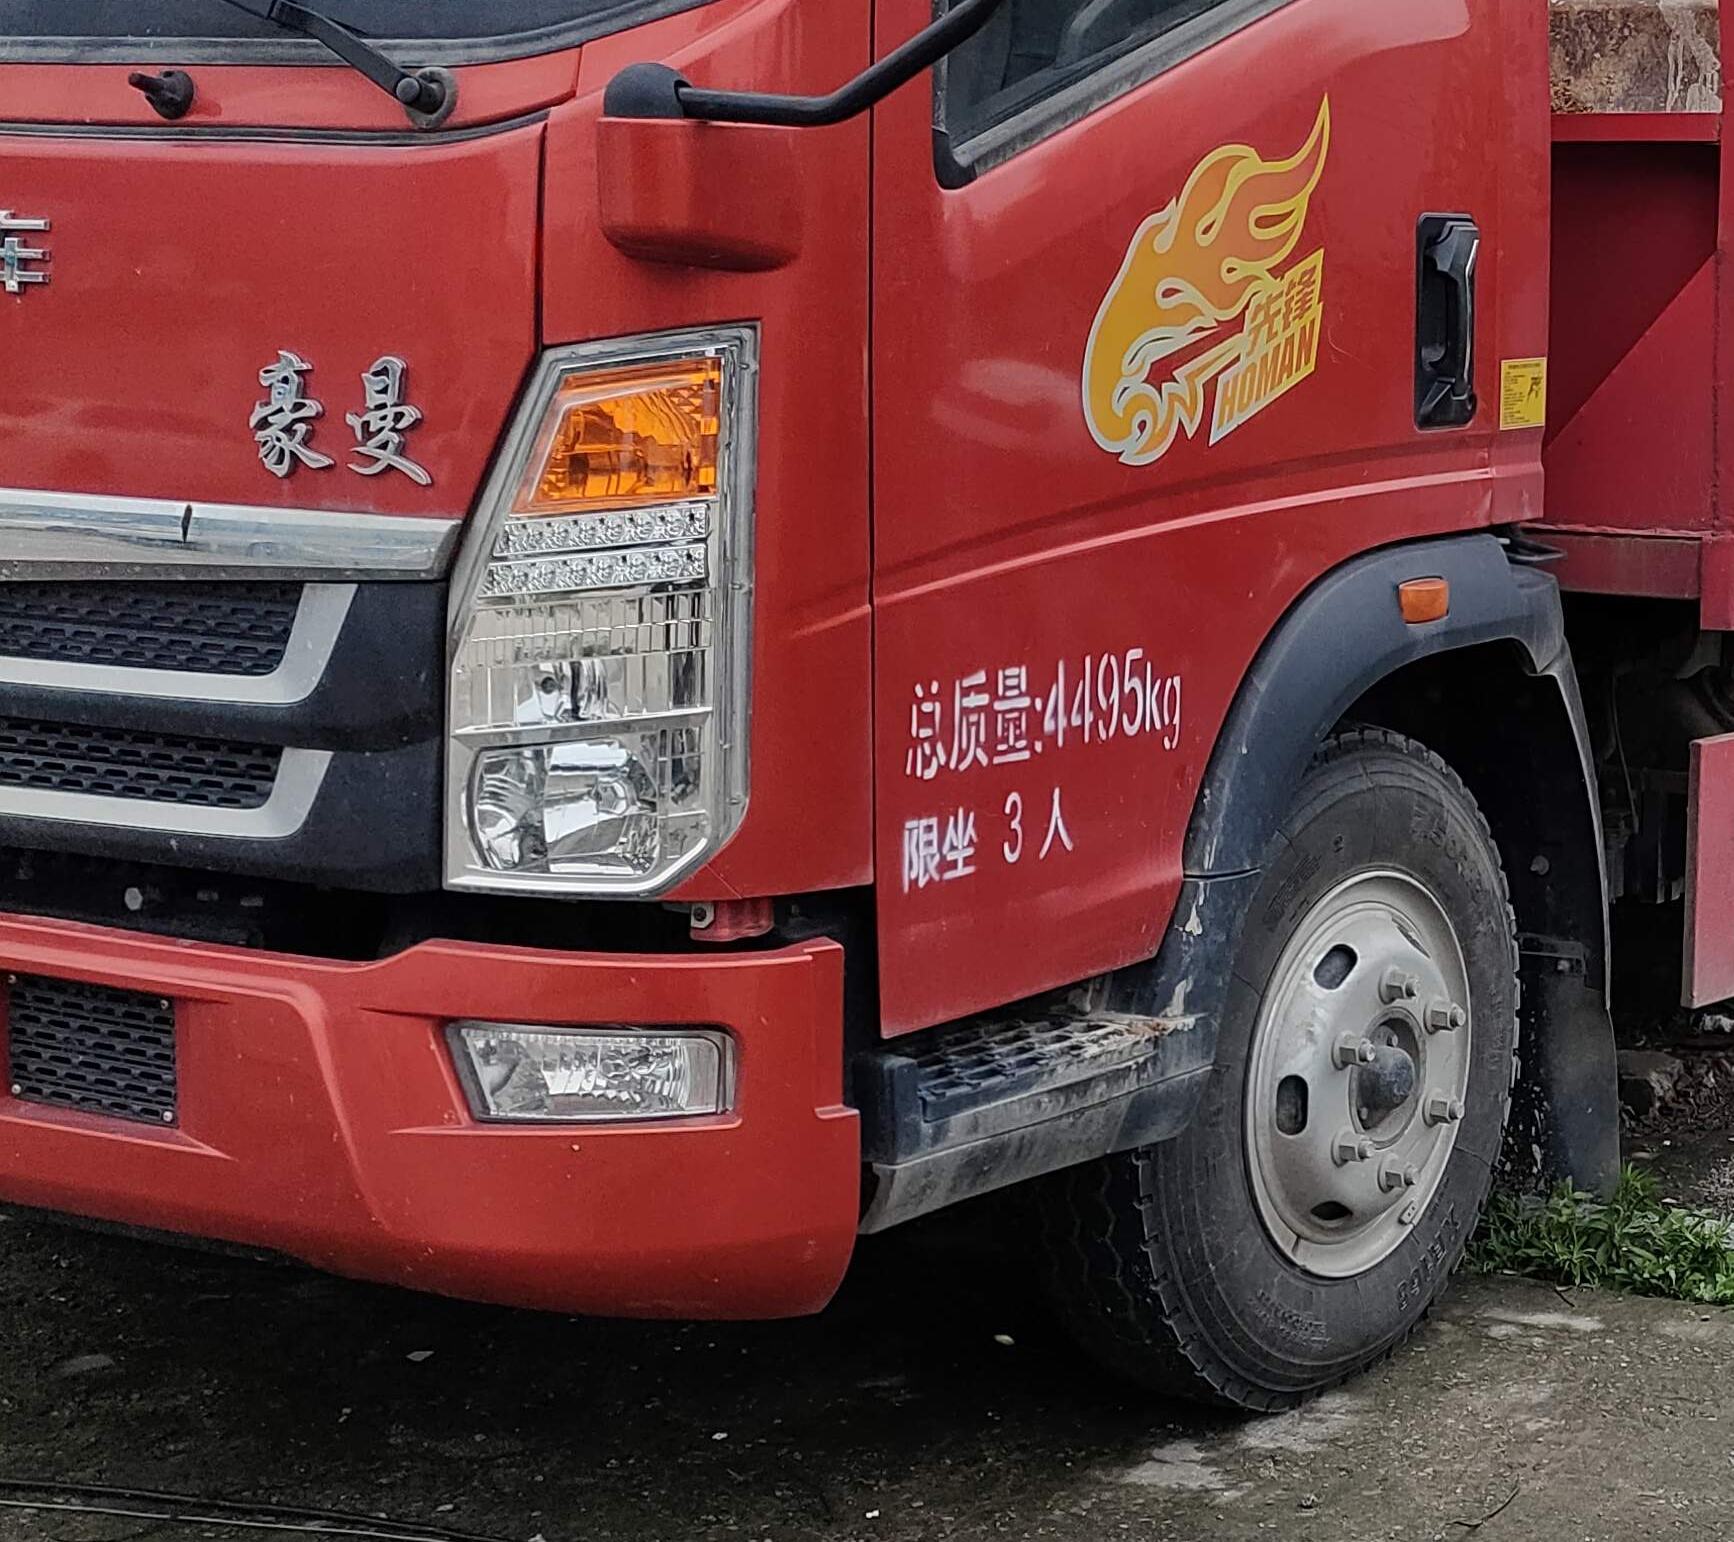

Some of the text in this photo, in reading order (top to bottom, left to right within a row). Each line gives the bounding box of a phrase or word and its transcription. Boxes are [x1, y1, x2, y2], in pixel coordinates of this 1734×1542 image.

[249, 349, 433, 486] 豪曼
[1217, 317, 1317, 431] HOMAN
[903, 787, 1073, 894] 限坐 3 人
